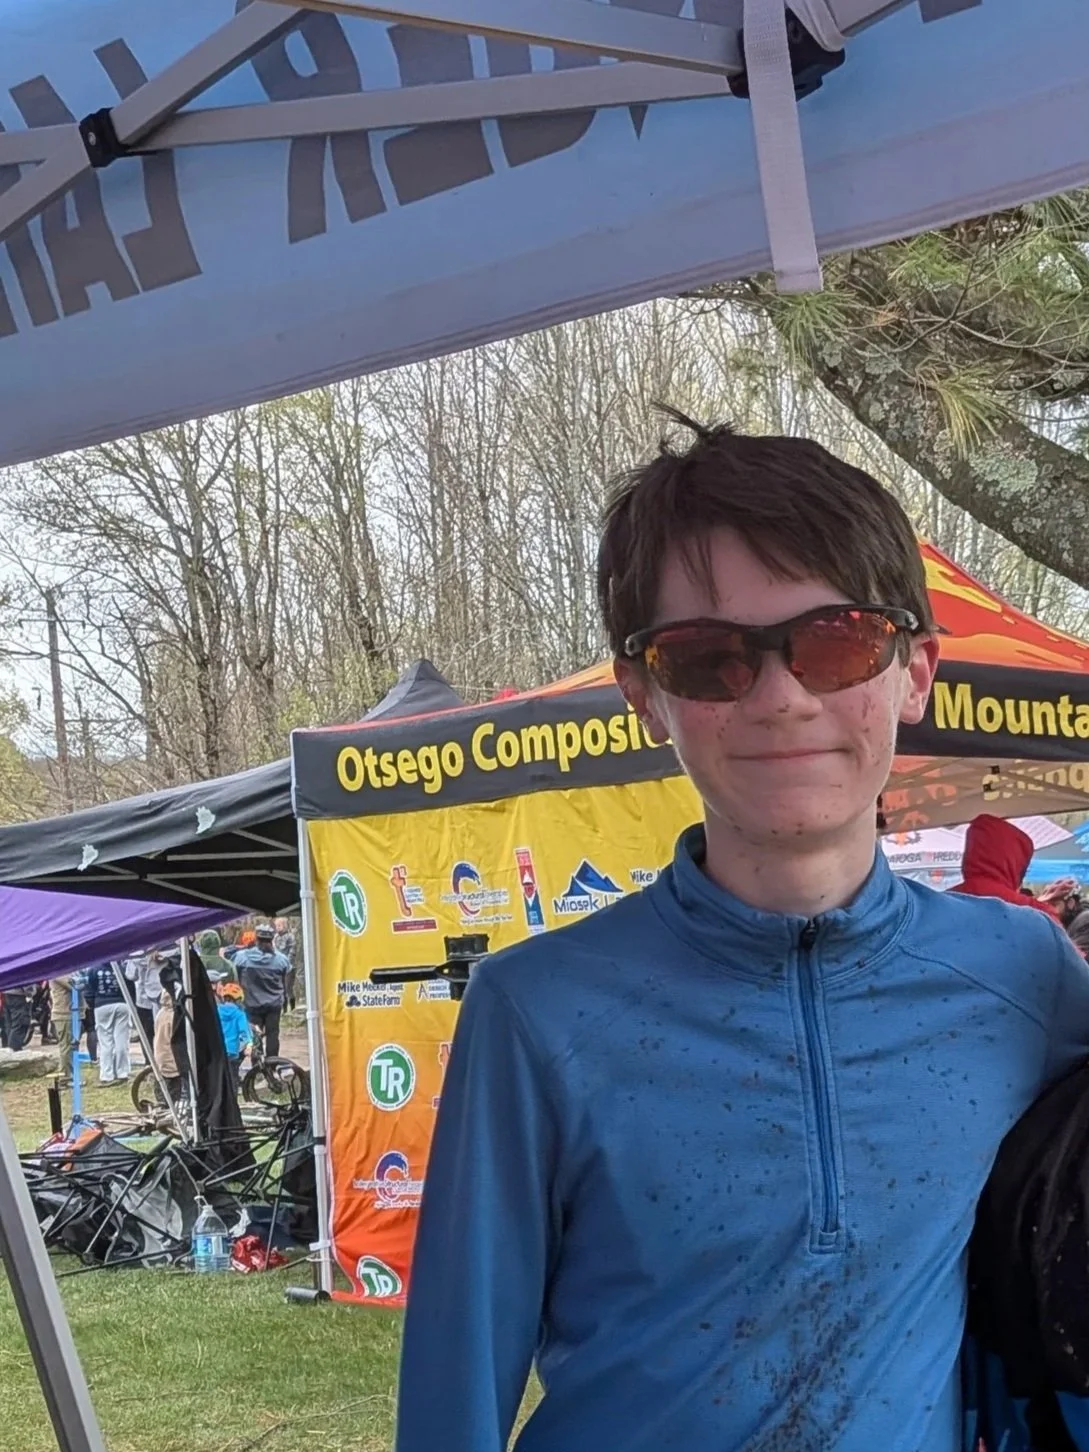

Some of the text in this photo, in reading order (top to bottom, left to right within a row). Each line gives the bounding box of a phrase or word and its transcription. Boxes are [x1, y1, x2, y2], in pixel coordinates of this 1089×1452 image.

[337, 741, 464, 795] Otsego
[338, 983, 360, 993] Mike
[372, 1058, 405, 1102] TR
